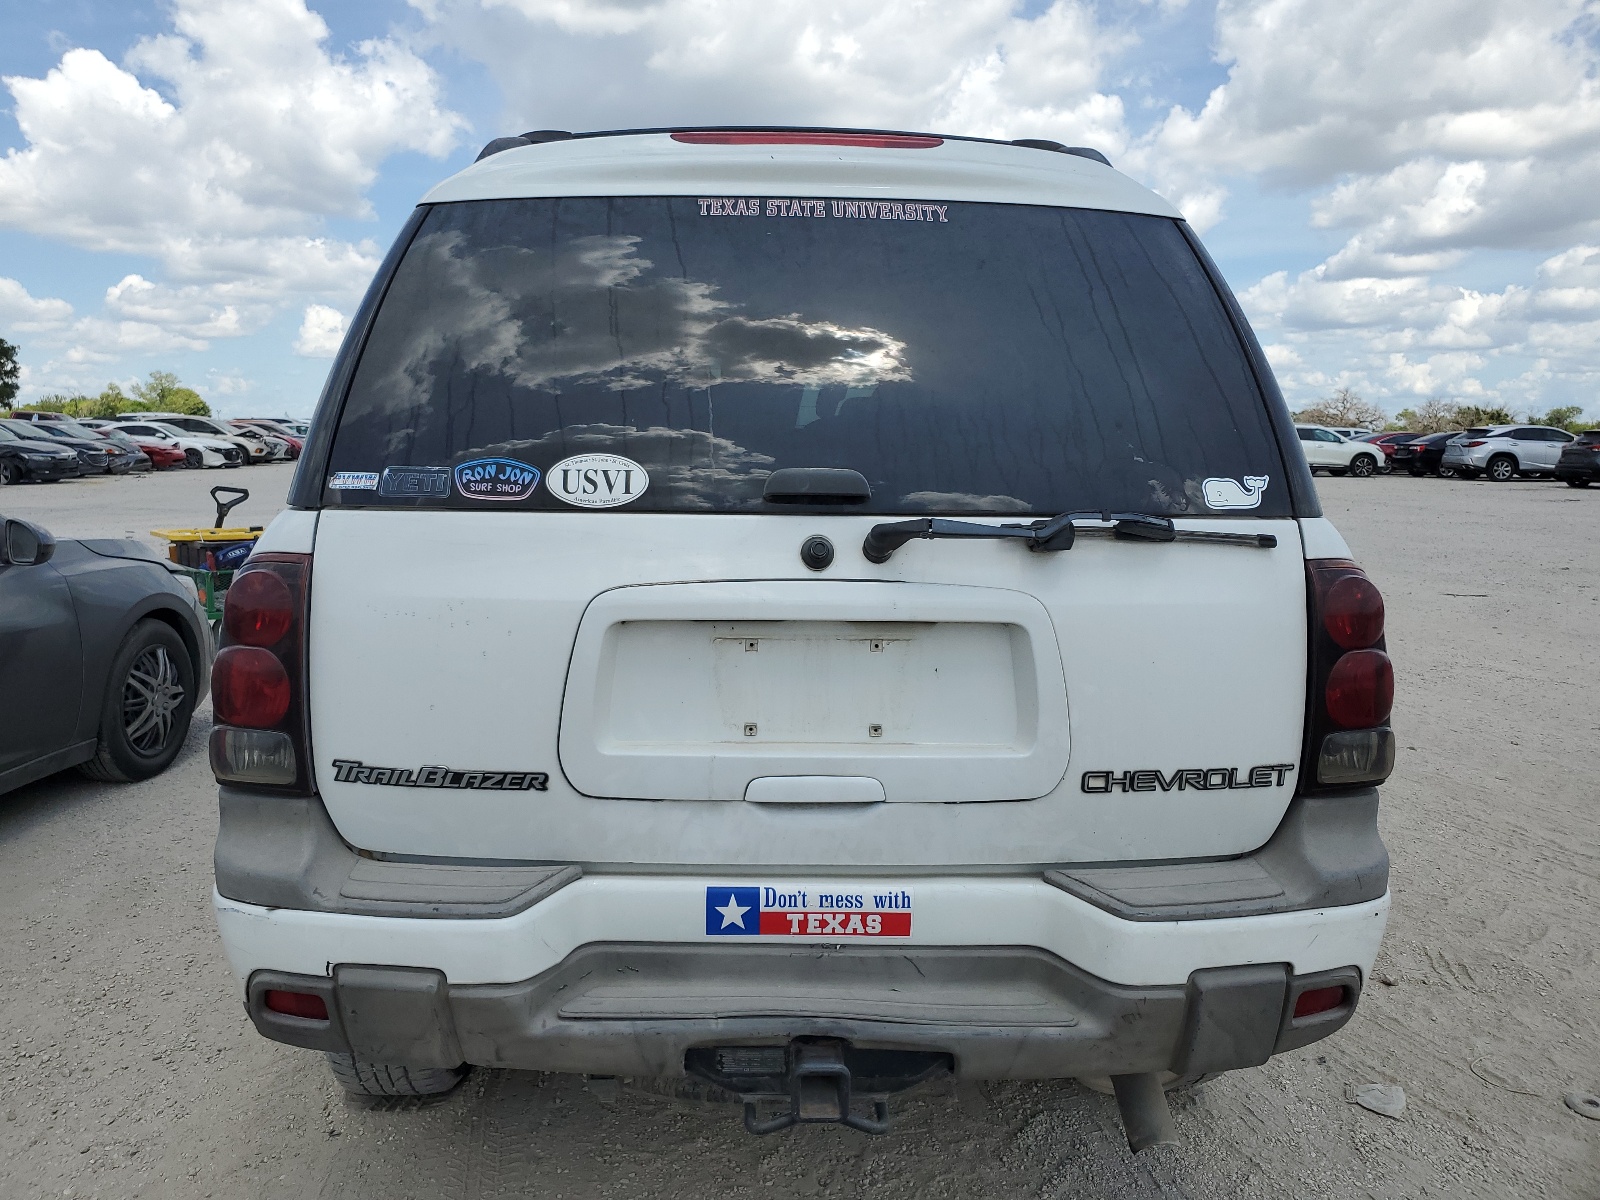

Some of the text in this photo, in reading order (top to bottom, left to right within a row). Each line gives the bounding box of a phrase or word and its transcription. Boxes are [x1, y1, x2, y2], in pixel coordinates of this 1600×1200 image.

[698, 199, 949, 223] TEXAS STATE UNIVERSITY
[386, 472, 448, 492] YETI
[462, 464, 534, 485] RON JON
[560, 468, 634, 495] USVI
[469, 482, 522, 493] SURF SHOP
[1081, 764, 1294, 793] CHEVROLET
[764, 887, 912, 909] Don't mess with
[786, 914, 882, 934] TEXAS
